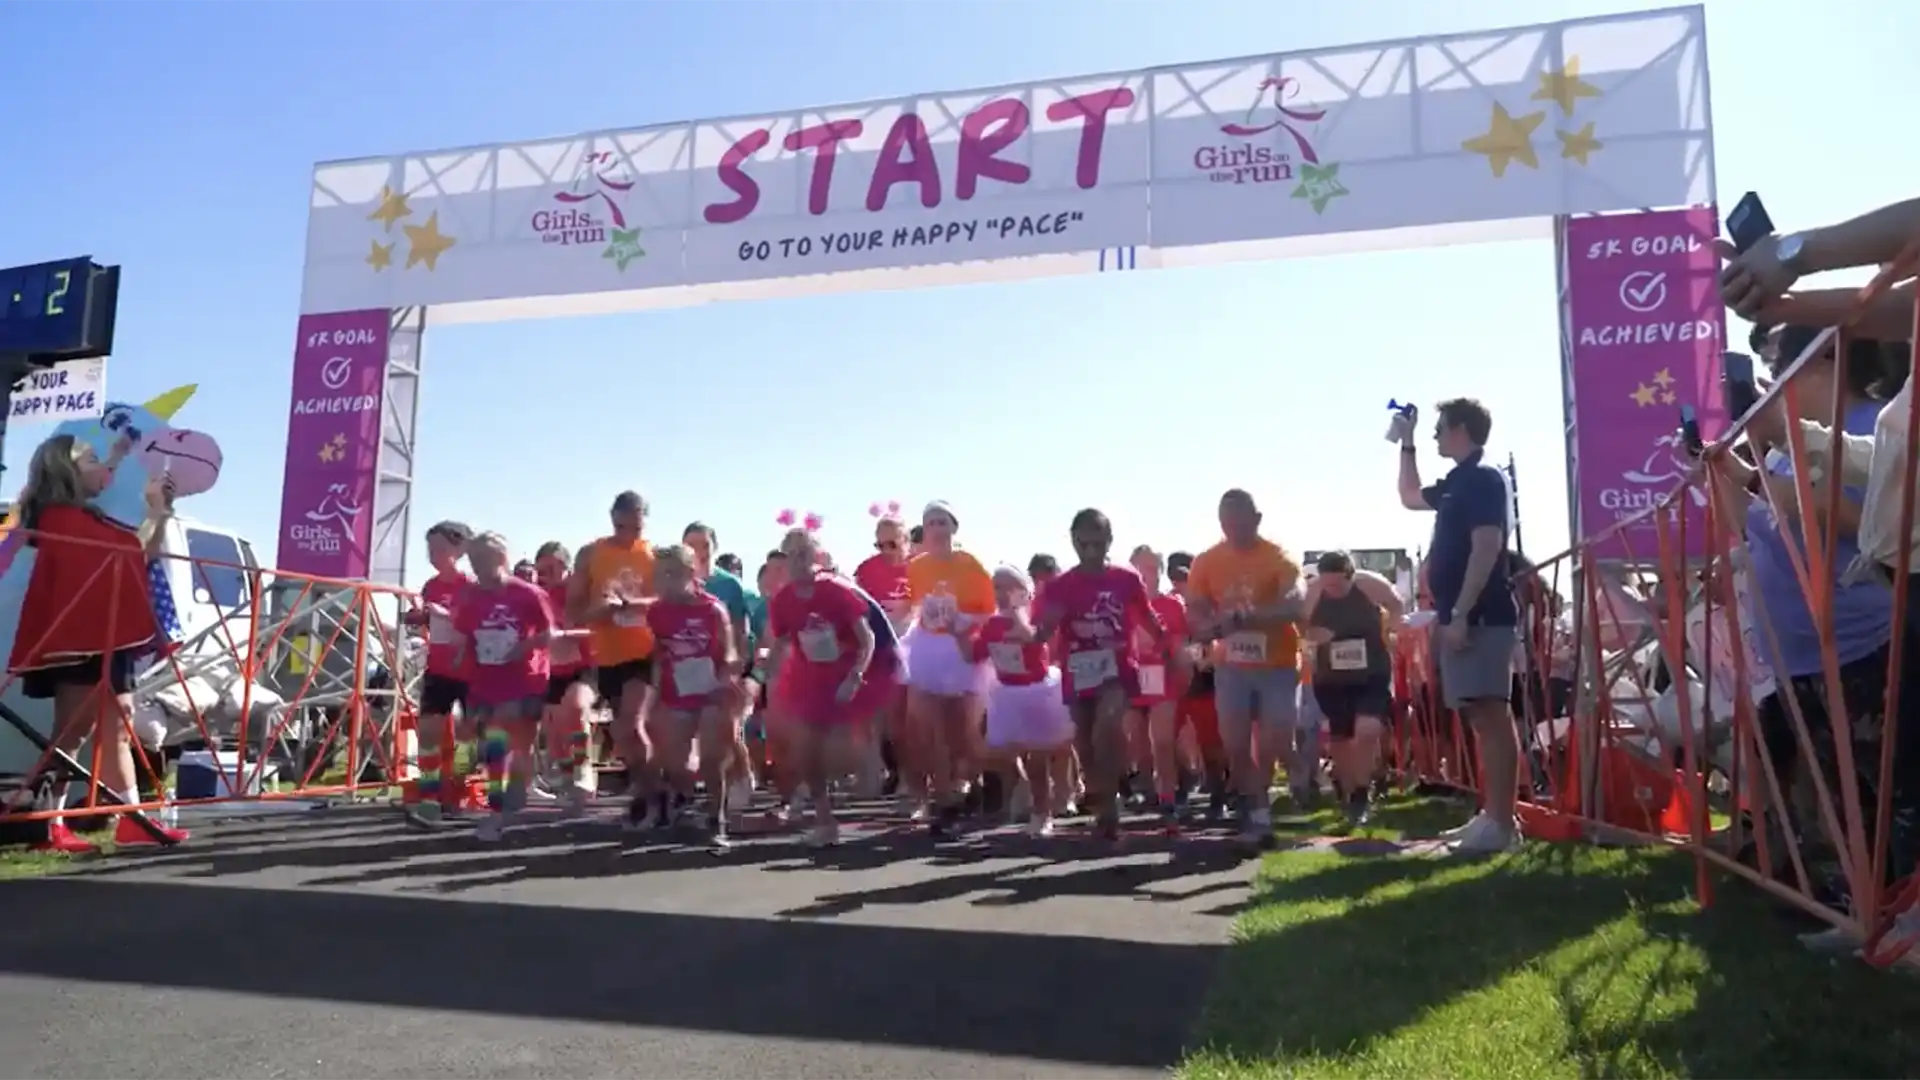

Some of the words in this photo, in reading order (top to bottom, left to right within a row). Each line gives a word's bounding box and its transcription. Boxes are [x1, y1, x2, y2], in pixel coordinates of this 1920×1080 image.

[703, 88, 1135, 224] START
[1194, 143, 1271, 170] Girls
[1233, 163, 1293, 184] run
[532, 209, 591, 232] Girls
[560, 228, 606, 245] run
[738, 241, 771, 262] GO
[779, 236, 812, 259] TO
[820, 230, 884, 254] YOUR
[892, 219, 977, 248] HAPPY
[1587, 239, 1622, 260] 5K
[1631, 233, 1702, 256] GOAL
[333, 328, 377, 345] GOAL
[1580, 320, 1720, 346] ACHIEVED!
[30, 370, 68, 390] YOUR
[12, 396, 52, 416] APPY
[56, 390, 95, 411] PACE
[294, 394, 379, 415] ACHIEVED!
[290, 524, 331, 540] Girls
[310, 537, 340, 551] run
